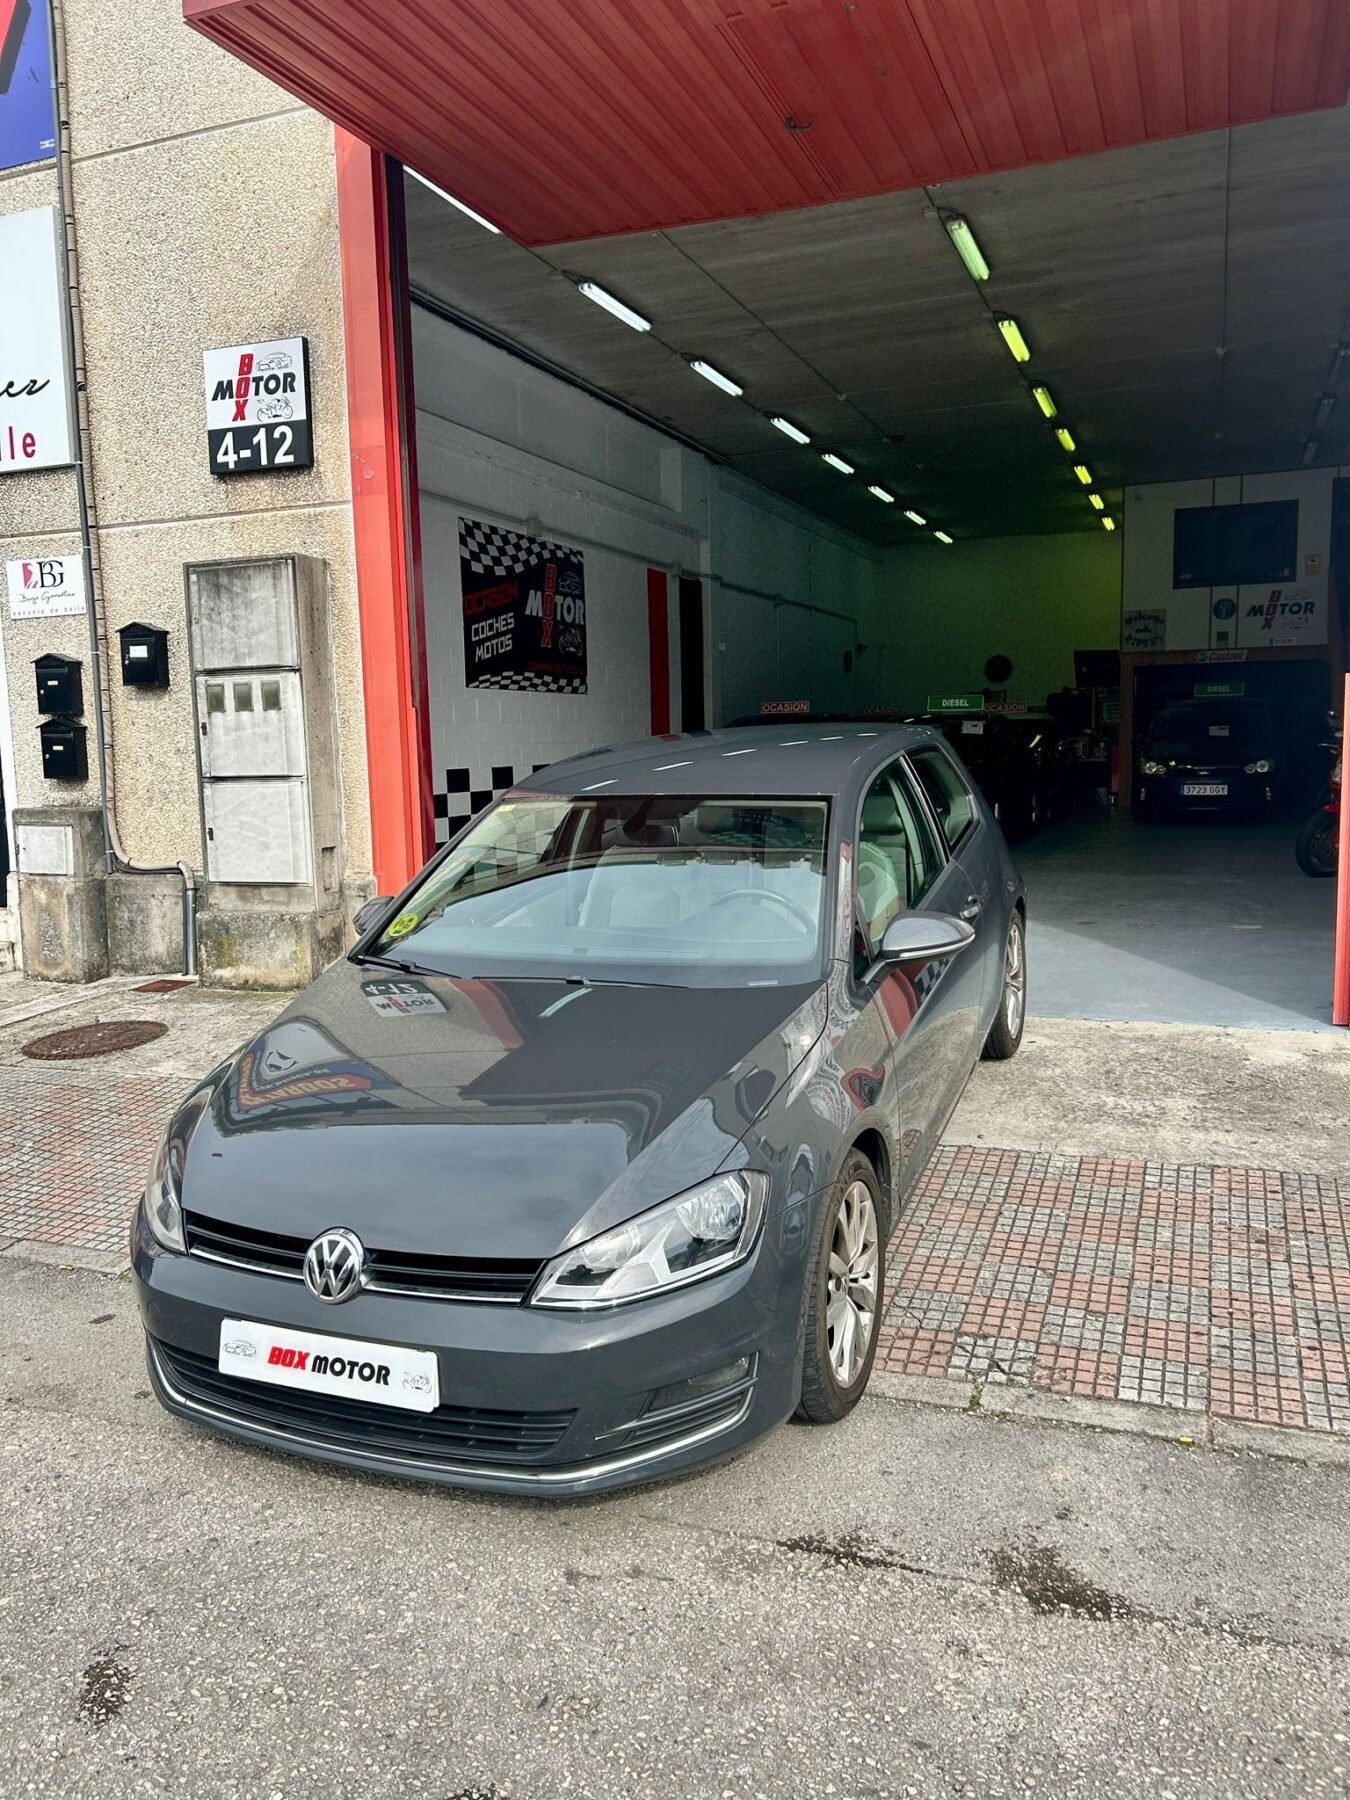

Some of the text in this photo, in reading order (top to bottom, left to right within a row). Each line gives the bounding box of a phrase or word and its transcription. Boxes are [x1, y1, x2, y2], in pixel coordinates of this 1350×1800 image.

[211, 372, 296, 402] MOTOR
[232, 353, 254, 422] BOX
[0, 426, 36, 460] le
[216, 424, 295, 469] 4-12
[525, 589, 585, 625] MOTOR
[540, 563, 557, 648] BOX
[1246, 601, 1315, 618] MOTOR
[471, 612, 515, 642] COCHES
[475, 634, 513, 662] MOTOS
[1207, 651, 1244, 662] Castrol
[941, 698, 969, 707] DIESEL
[1207, 685, 1231, 693] DIESEL
[762, 702, 808, 713] OCASION
[1186, 786, 1207, 794] 3723
[267, 1346, 391, 1386] BOX MOTOR
